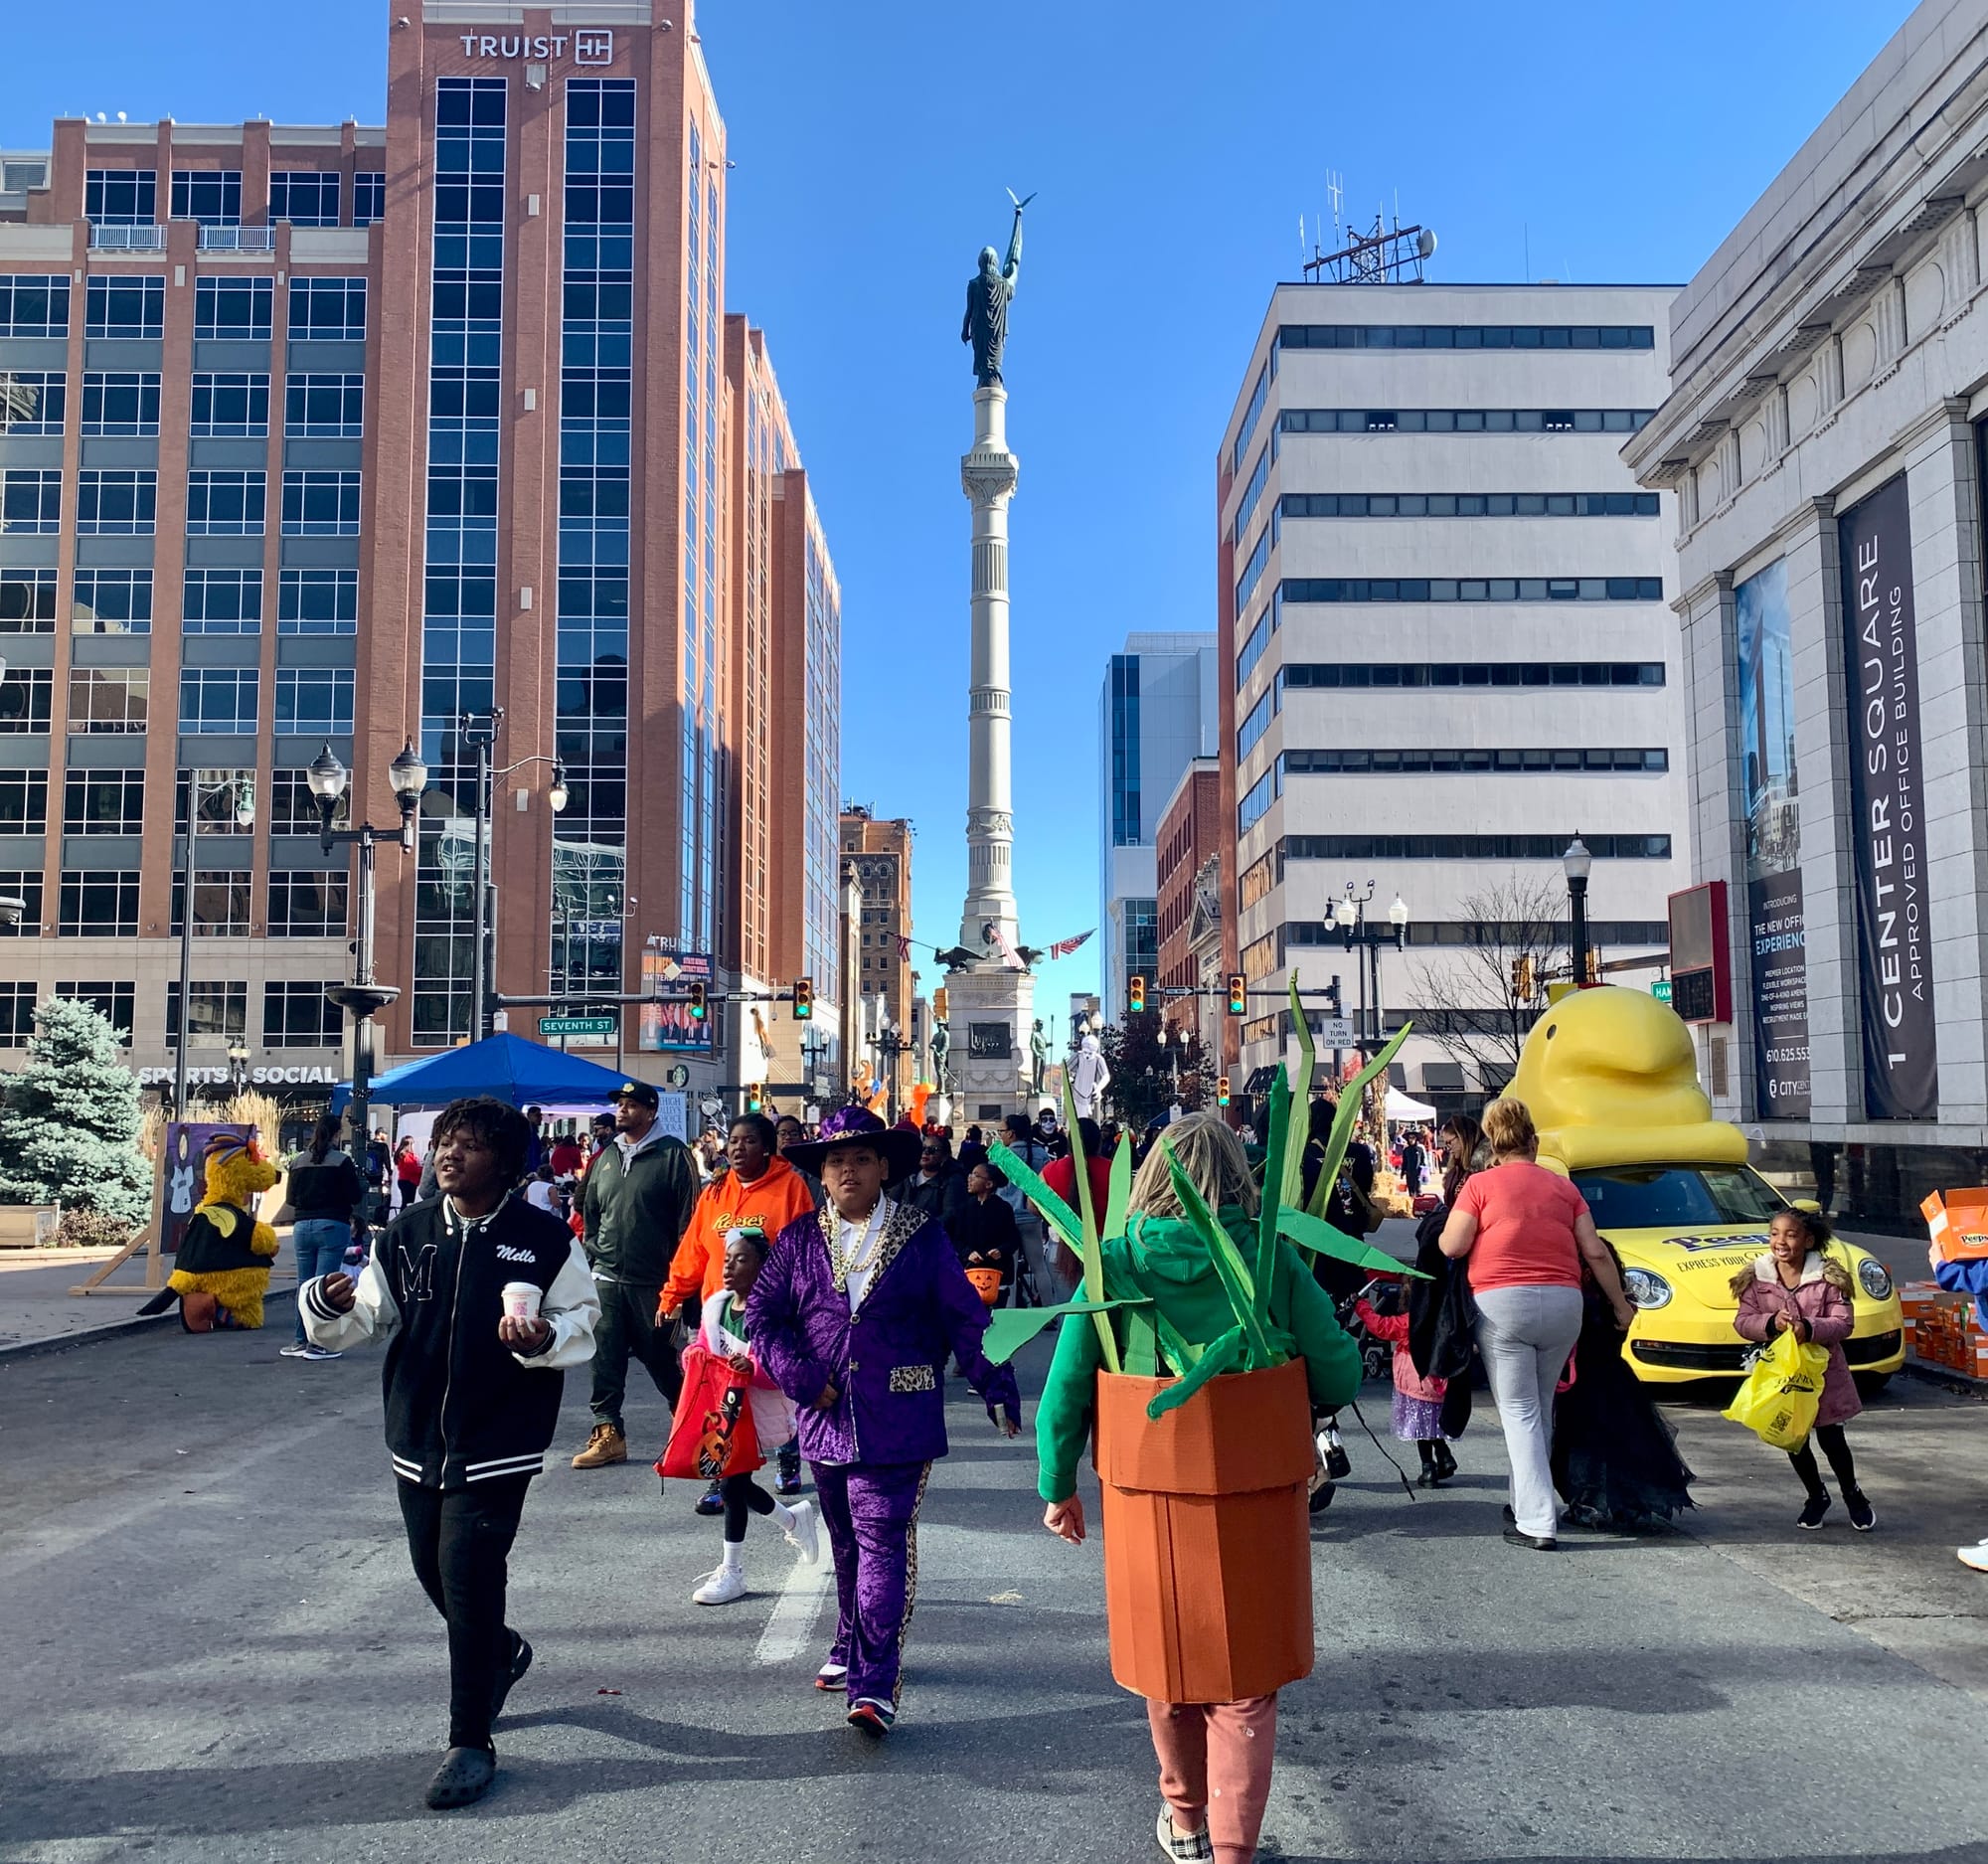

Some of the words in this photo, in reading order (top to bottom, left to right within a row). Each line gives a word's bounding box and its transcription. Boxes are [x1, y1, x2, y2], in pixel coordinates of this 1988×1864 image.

[460, 36, 568, 58] TRUIST
[1859, 535, 1888, 774] SQUARE
[1890, 586, 1906, 720] BUILDING
[1896, 729, 1913, 832] OFFICE
[1762, 894, 1797, 911] INTRODUCING
[1872, 794, 1904, 1028] CENTER
[1754, 923, 1766, 936] THE
[1766, 919, 1783, 933] NEW
[1903, 843, 1923, 1001] APPROVED
[1782, 964, 1804, 975] LOCATION
[1790, 1000, 1805, 1009] VIEWS
[544, 1022, 592, 1031] SEVENTH
[1888, 1053, 1906, 1070] 1
[138, 1067, 229, 1084] SPORTS
[252, 1066, 338, 1084] SOCIAL
[496, 1245, 536, 1264] Mello
[398, 1244, 437, 1302] M
[1677, 1258, 1722, 1272] EXPRESS
